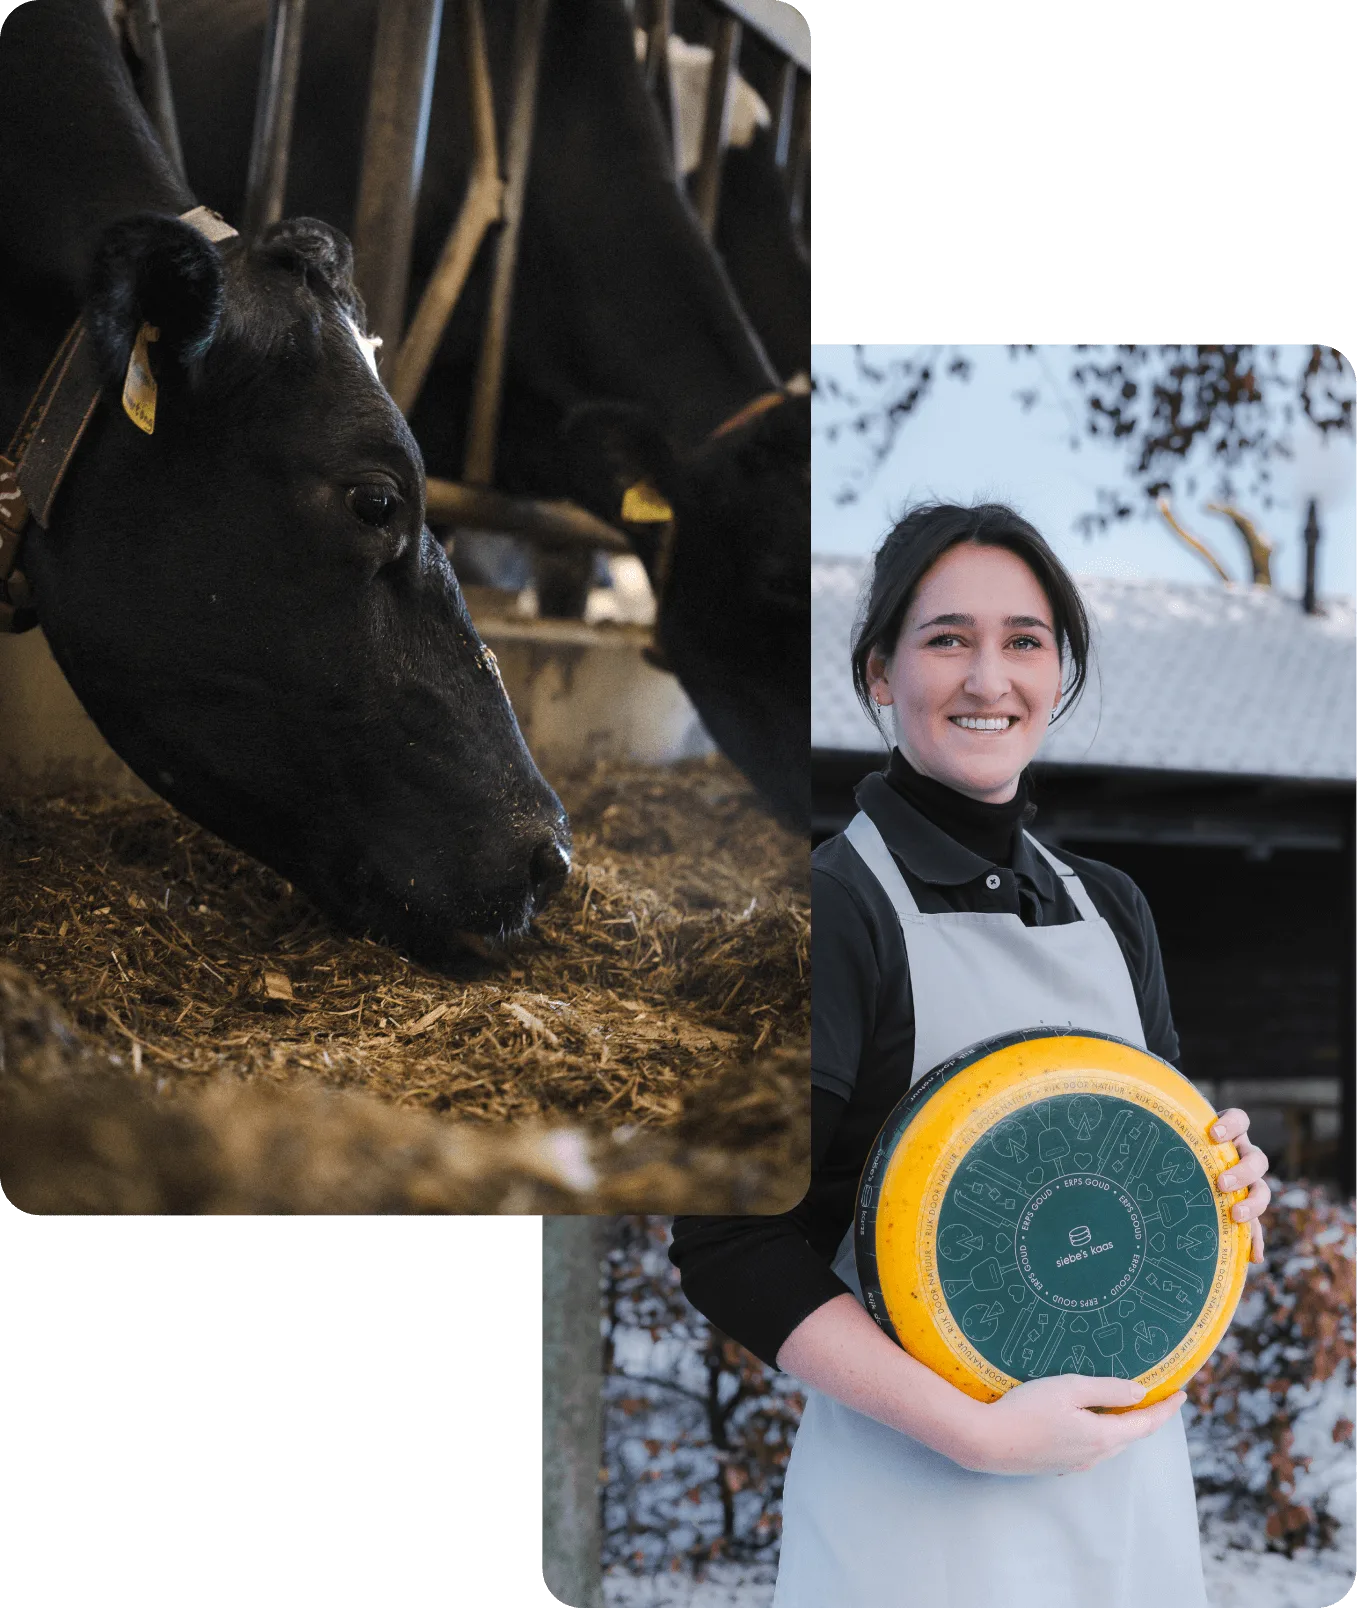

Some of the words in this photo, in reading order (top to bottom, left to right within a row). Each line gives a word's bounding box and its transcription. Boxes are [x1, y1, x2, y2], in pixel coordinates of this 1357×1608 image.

[1044, 1084, 1060, 1093] RIJK
[1064, 1081, 1090, 1089] DOOR
[1092, 1082, 1125, 1094] NATUUR
[1002, 1092, 1032, 1110] NATUUR
[1135, 1092, 1152, 1106] RIJK
[1153, 1102, 1174, 1120] DOOR
[1174, 1116, 1198, 1147] NATUUR
[925, 1218, 933, 1236] RIJK
[929, 1192, 940, 1216] DOOR
[938, 1152, 958, 1186] NATUUR
[1064, 1178, 1082, 1188] ERPS
[1085, 1180, 1110, 1191] GOUD
[1202, 1154, 1214, 1172] RIJK
[1211, 1173, 1223, 1199] DOOR
[1219, 1200, 1229, 1236] NATUUR
[1022, 1212, 1034, 1230] ERPS
[1032, 1189, 1052, 1210] GOUD
[1119, 1195, 1134, 1212] ERPS
[1130, 1214, 1142, 1240] GOUD
[1020, 1245, 1031, 1272] GOUD
[1056, 1249, 1088, 1268] siebe's
[1090, 1242, 1114, 1255] kaas
[1128, 1254, 1140, 1273] ERPS
[924, 1249, 936, 1286] NATUUR
[1028, 1272, 1043, 1290] ERPS
[1110, 1274, 1131, 1296] GOUD
[1215, 1268, 1224, 1295] DOOR
[931, 1289, 945, 1314] DOOR
[1052, 1295, 1077, 1307] GOUD
[1080, 1298, 1098, 1307] ERPS
[1198, 1296, 1216, 1329] NATUUR
[942, 1316, 954, 1333] RIJK
[957, 1342, 984, 1369] NATUUR
[1181, 1337, 1194, 1353] RIJK
[1159, 1353, 1180, 1373] DOOR
[985, 1367, 1007, 1385] DOOR
